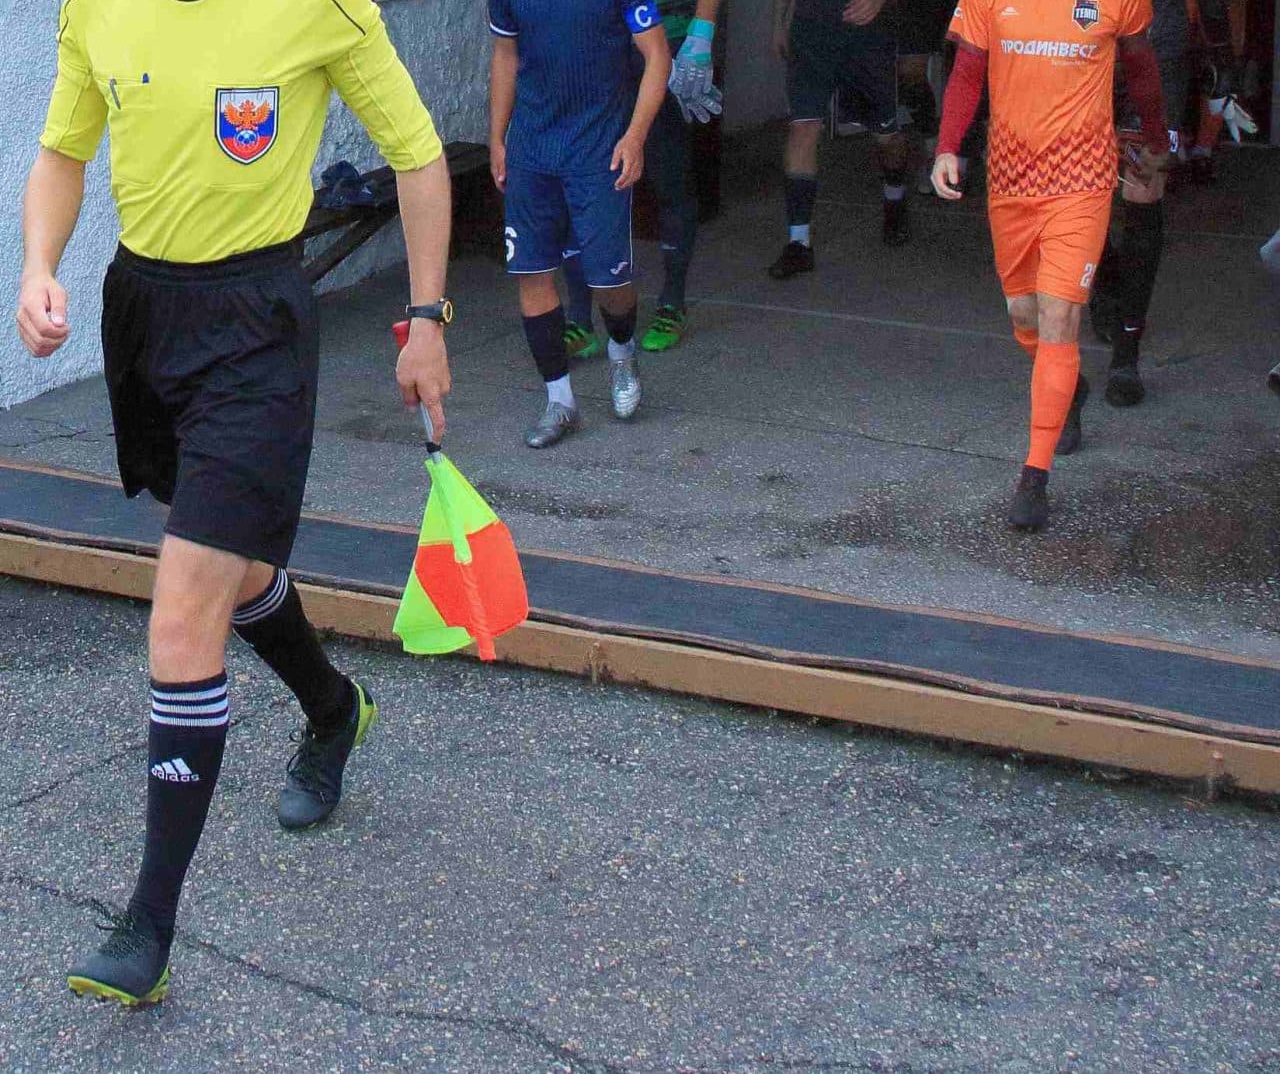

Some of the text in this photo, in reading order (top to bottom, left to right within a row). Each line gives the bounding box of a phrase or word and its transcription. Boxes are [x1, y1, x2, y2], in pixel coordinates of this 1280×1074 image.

[634, 5, 652, 27] C
[1075, 7, 1097, 21] ТЕМП
[1000, 38, 1097, 58] ПРОДИНВЕСТ
[151, 767, 200, 783] adidas
